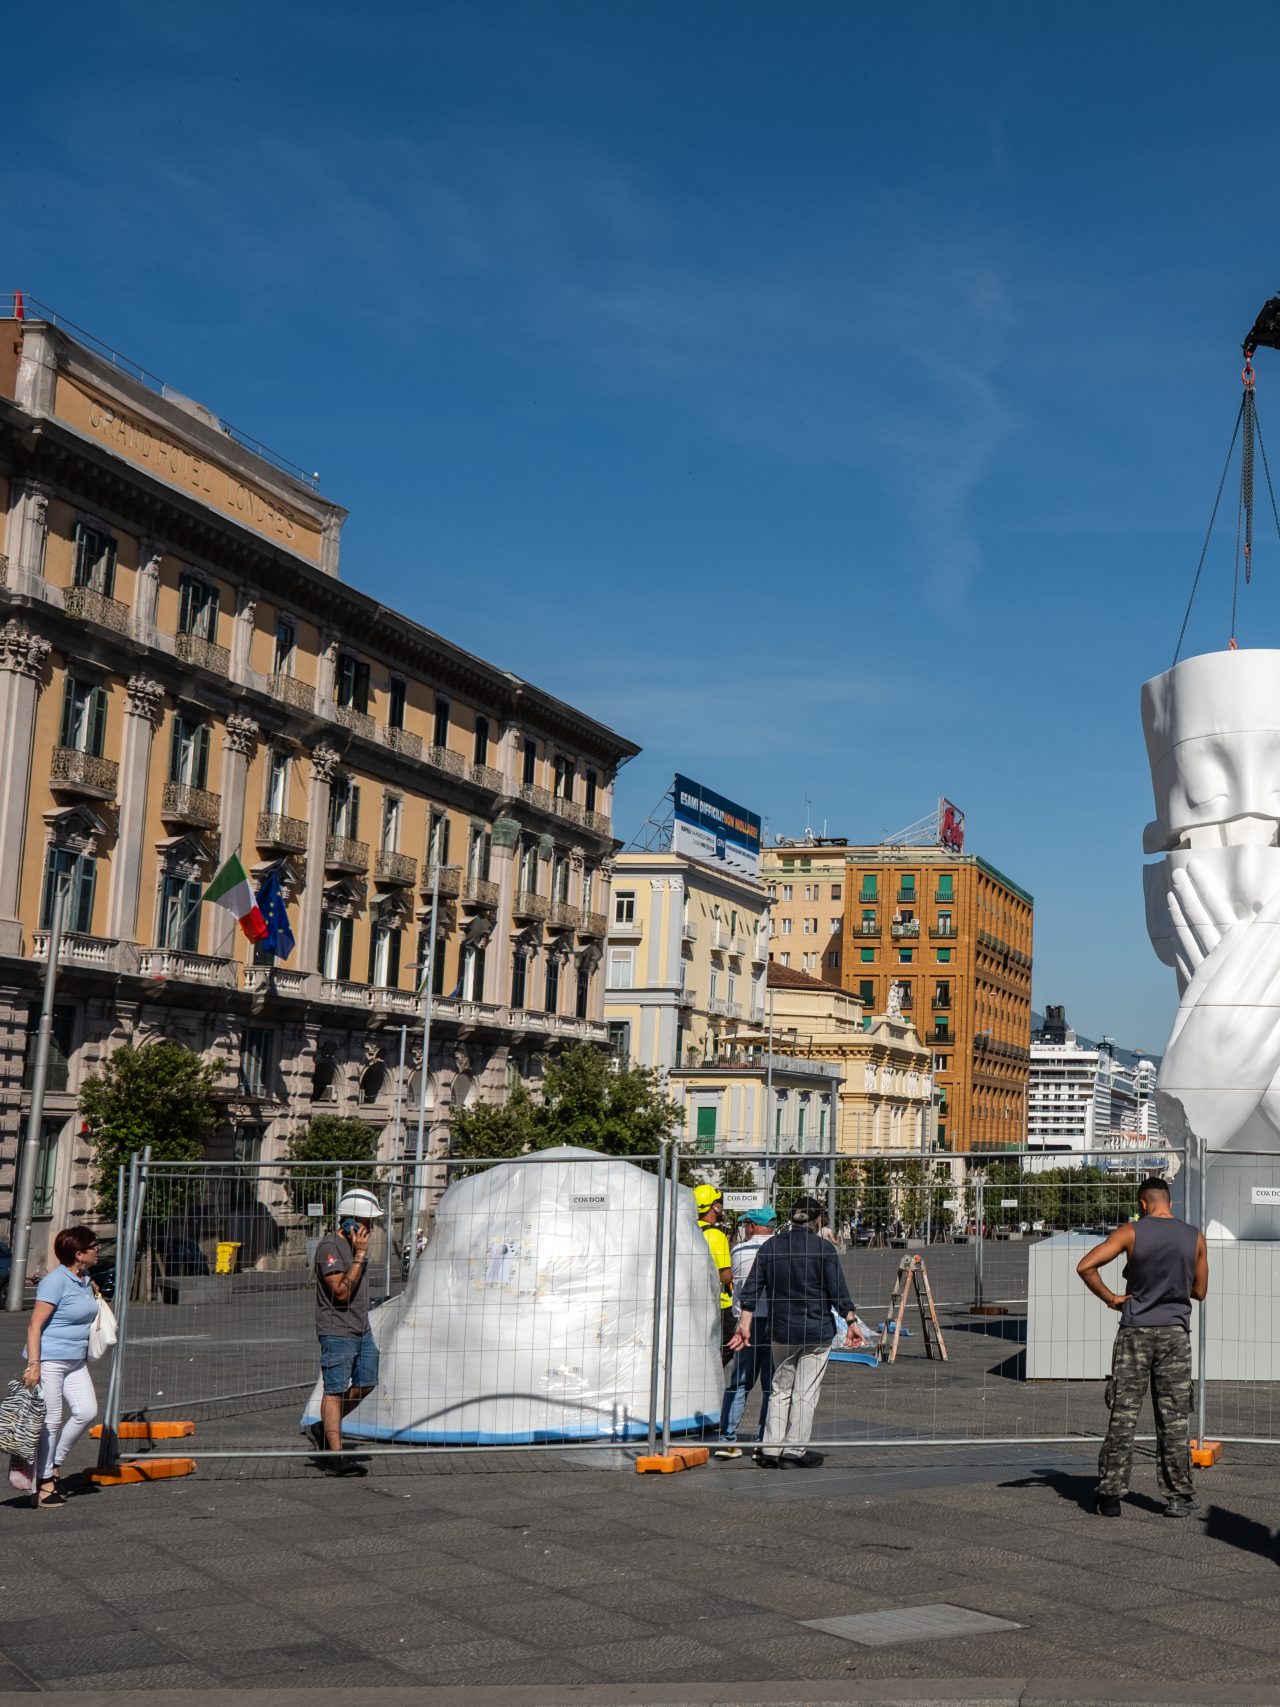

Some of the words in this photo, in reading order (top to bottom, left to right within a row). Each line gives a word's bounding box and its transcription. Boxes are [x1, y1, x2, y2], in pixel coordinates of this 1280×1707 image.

[90, 400, 153, 458] GRAND
[158, 437, 211, 493] HOTEL
[226, 478, 295, 539] LONDRES
[681, 791, 699, 811] ESAMI
